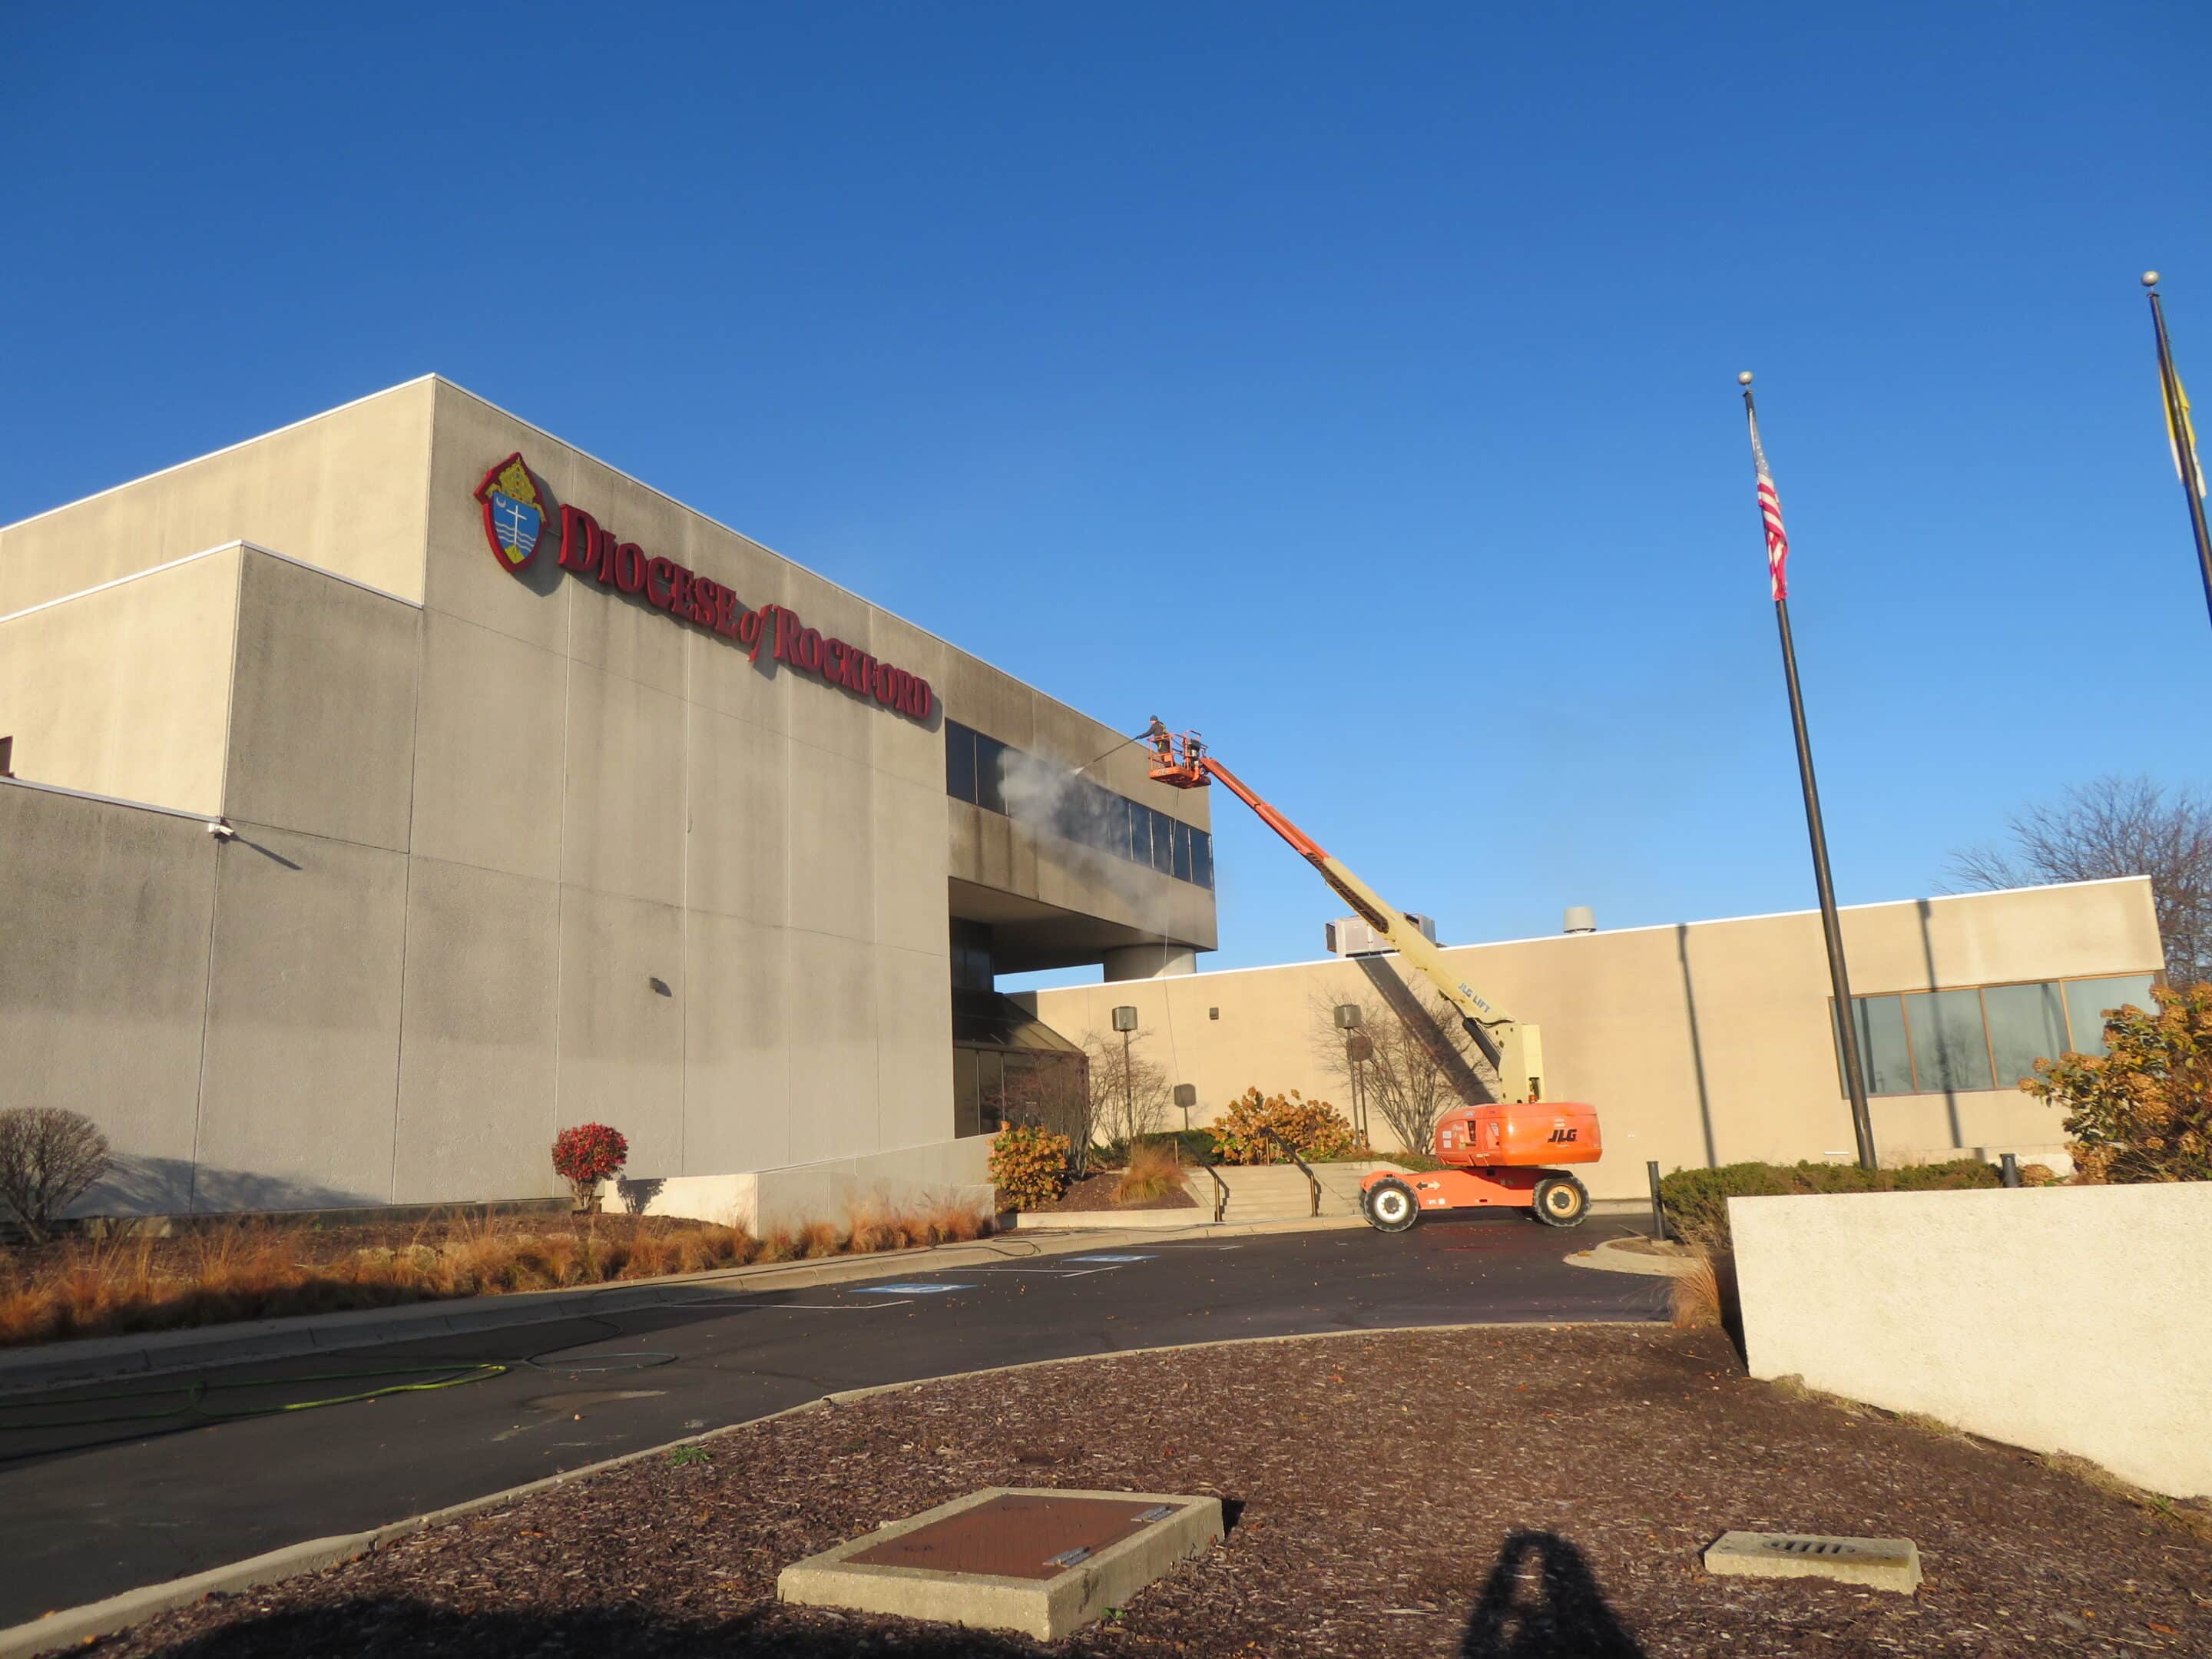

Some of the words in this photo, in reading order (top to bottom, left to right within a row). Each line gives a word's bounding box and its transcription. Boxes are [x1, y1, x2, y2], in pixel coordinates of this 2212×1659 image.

[558, 504, 737, 639] DIOCESE
[739, 603, 774, 663] of
[773, 605, 932, 720] ROCKFORD
[1458, 982, 1473, 998] JLG
[1472, 995, 1491, 1013] LIFT
[1548, 1129, 1578, 1143] JLG
